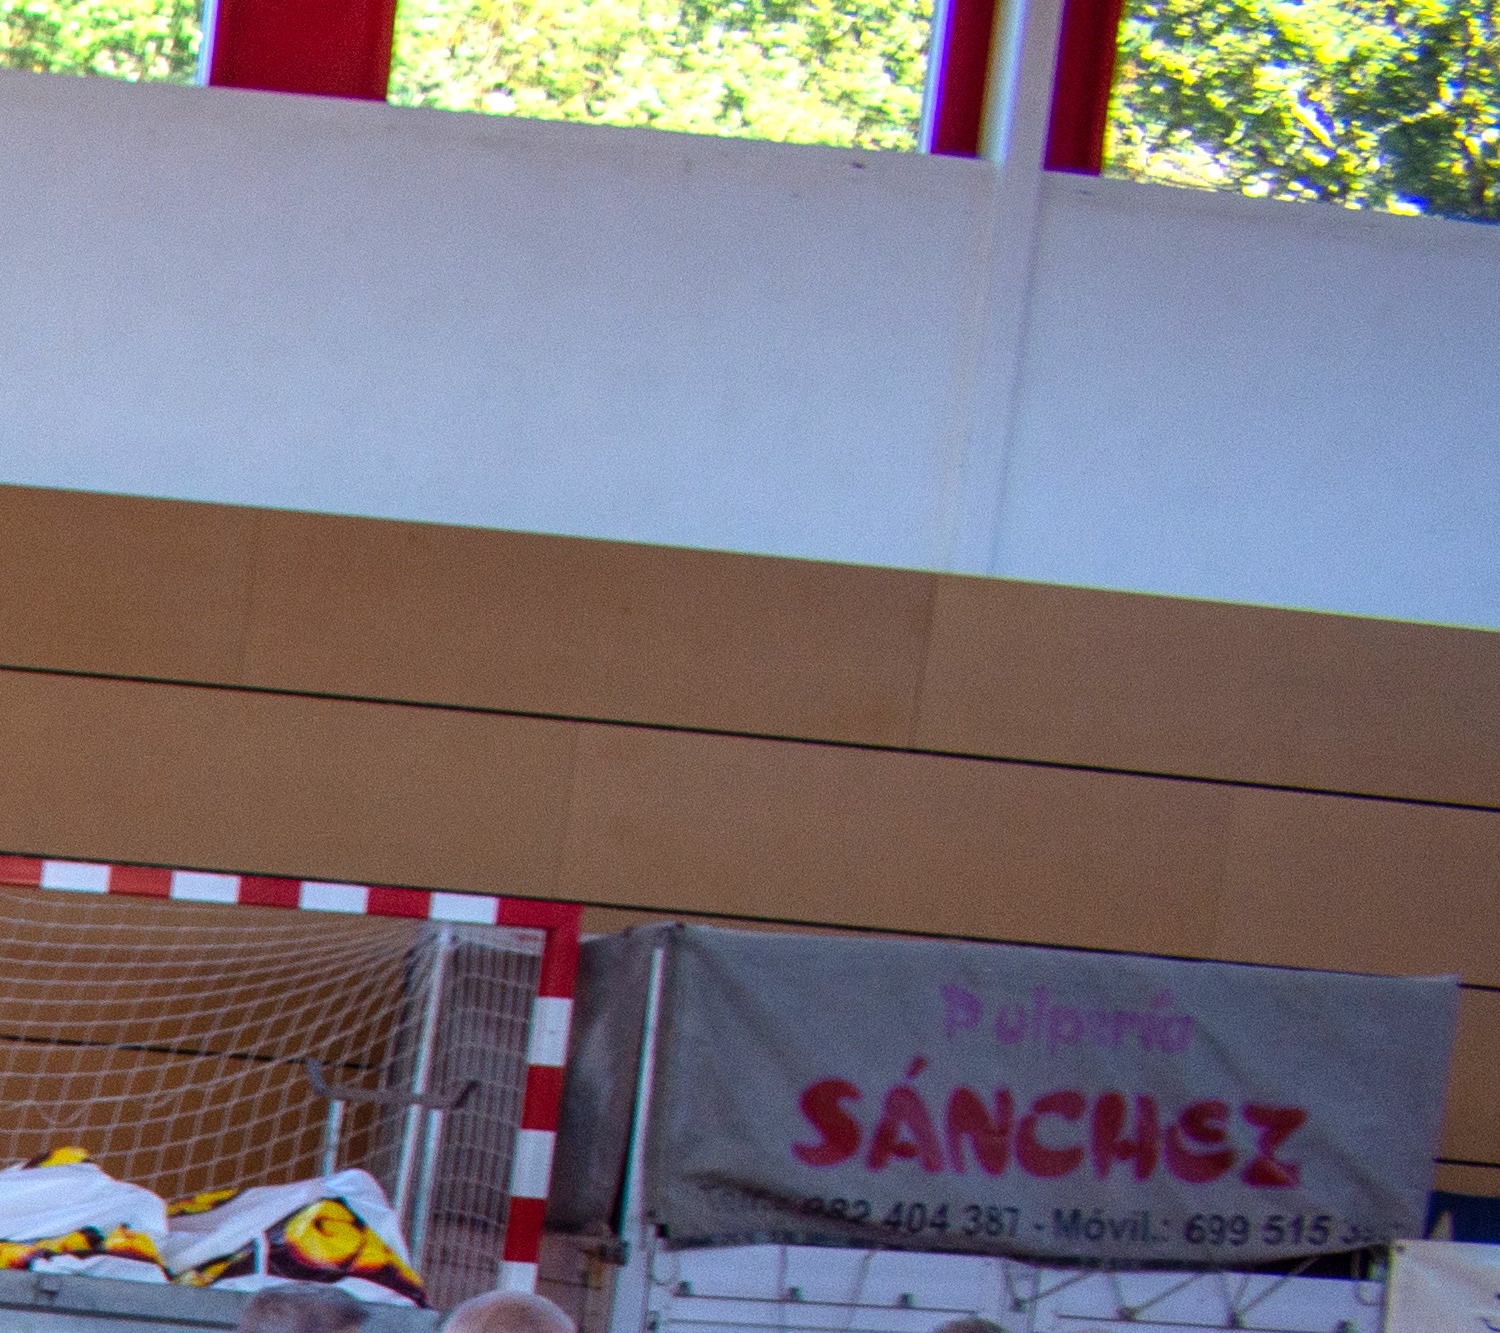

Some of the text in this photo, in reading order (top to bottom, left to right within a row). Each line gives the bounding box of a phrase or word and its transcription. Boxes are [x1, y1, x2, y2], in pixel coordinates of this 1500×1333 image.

[792, 1056, 1307, 1188] SÁNCHEZ
[881, 1202, 950, 1234] 404
[964, 1204, 1019, 1237] 387
[1184, 1214, 1250, 1246] 699
[1263, 1214, 1332, 1246] 515
